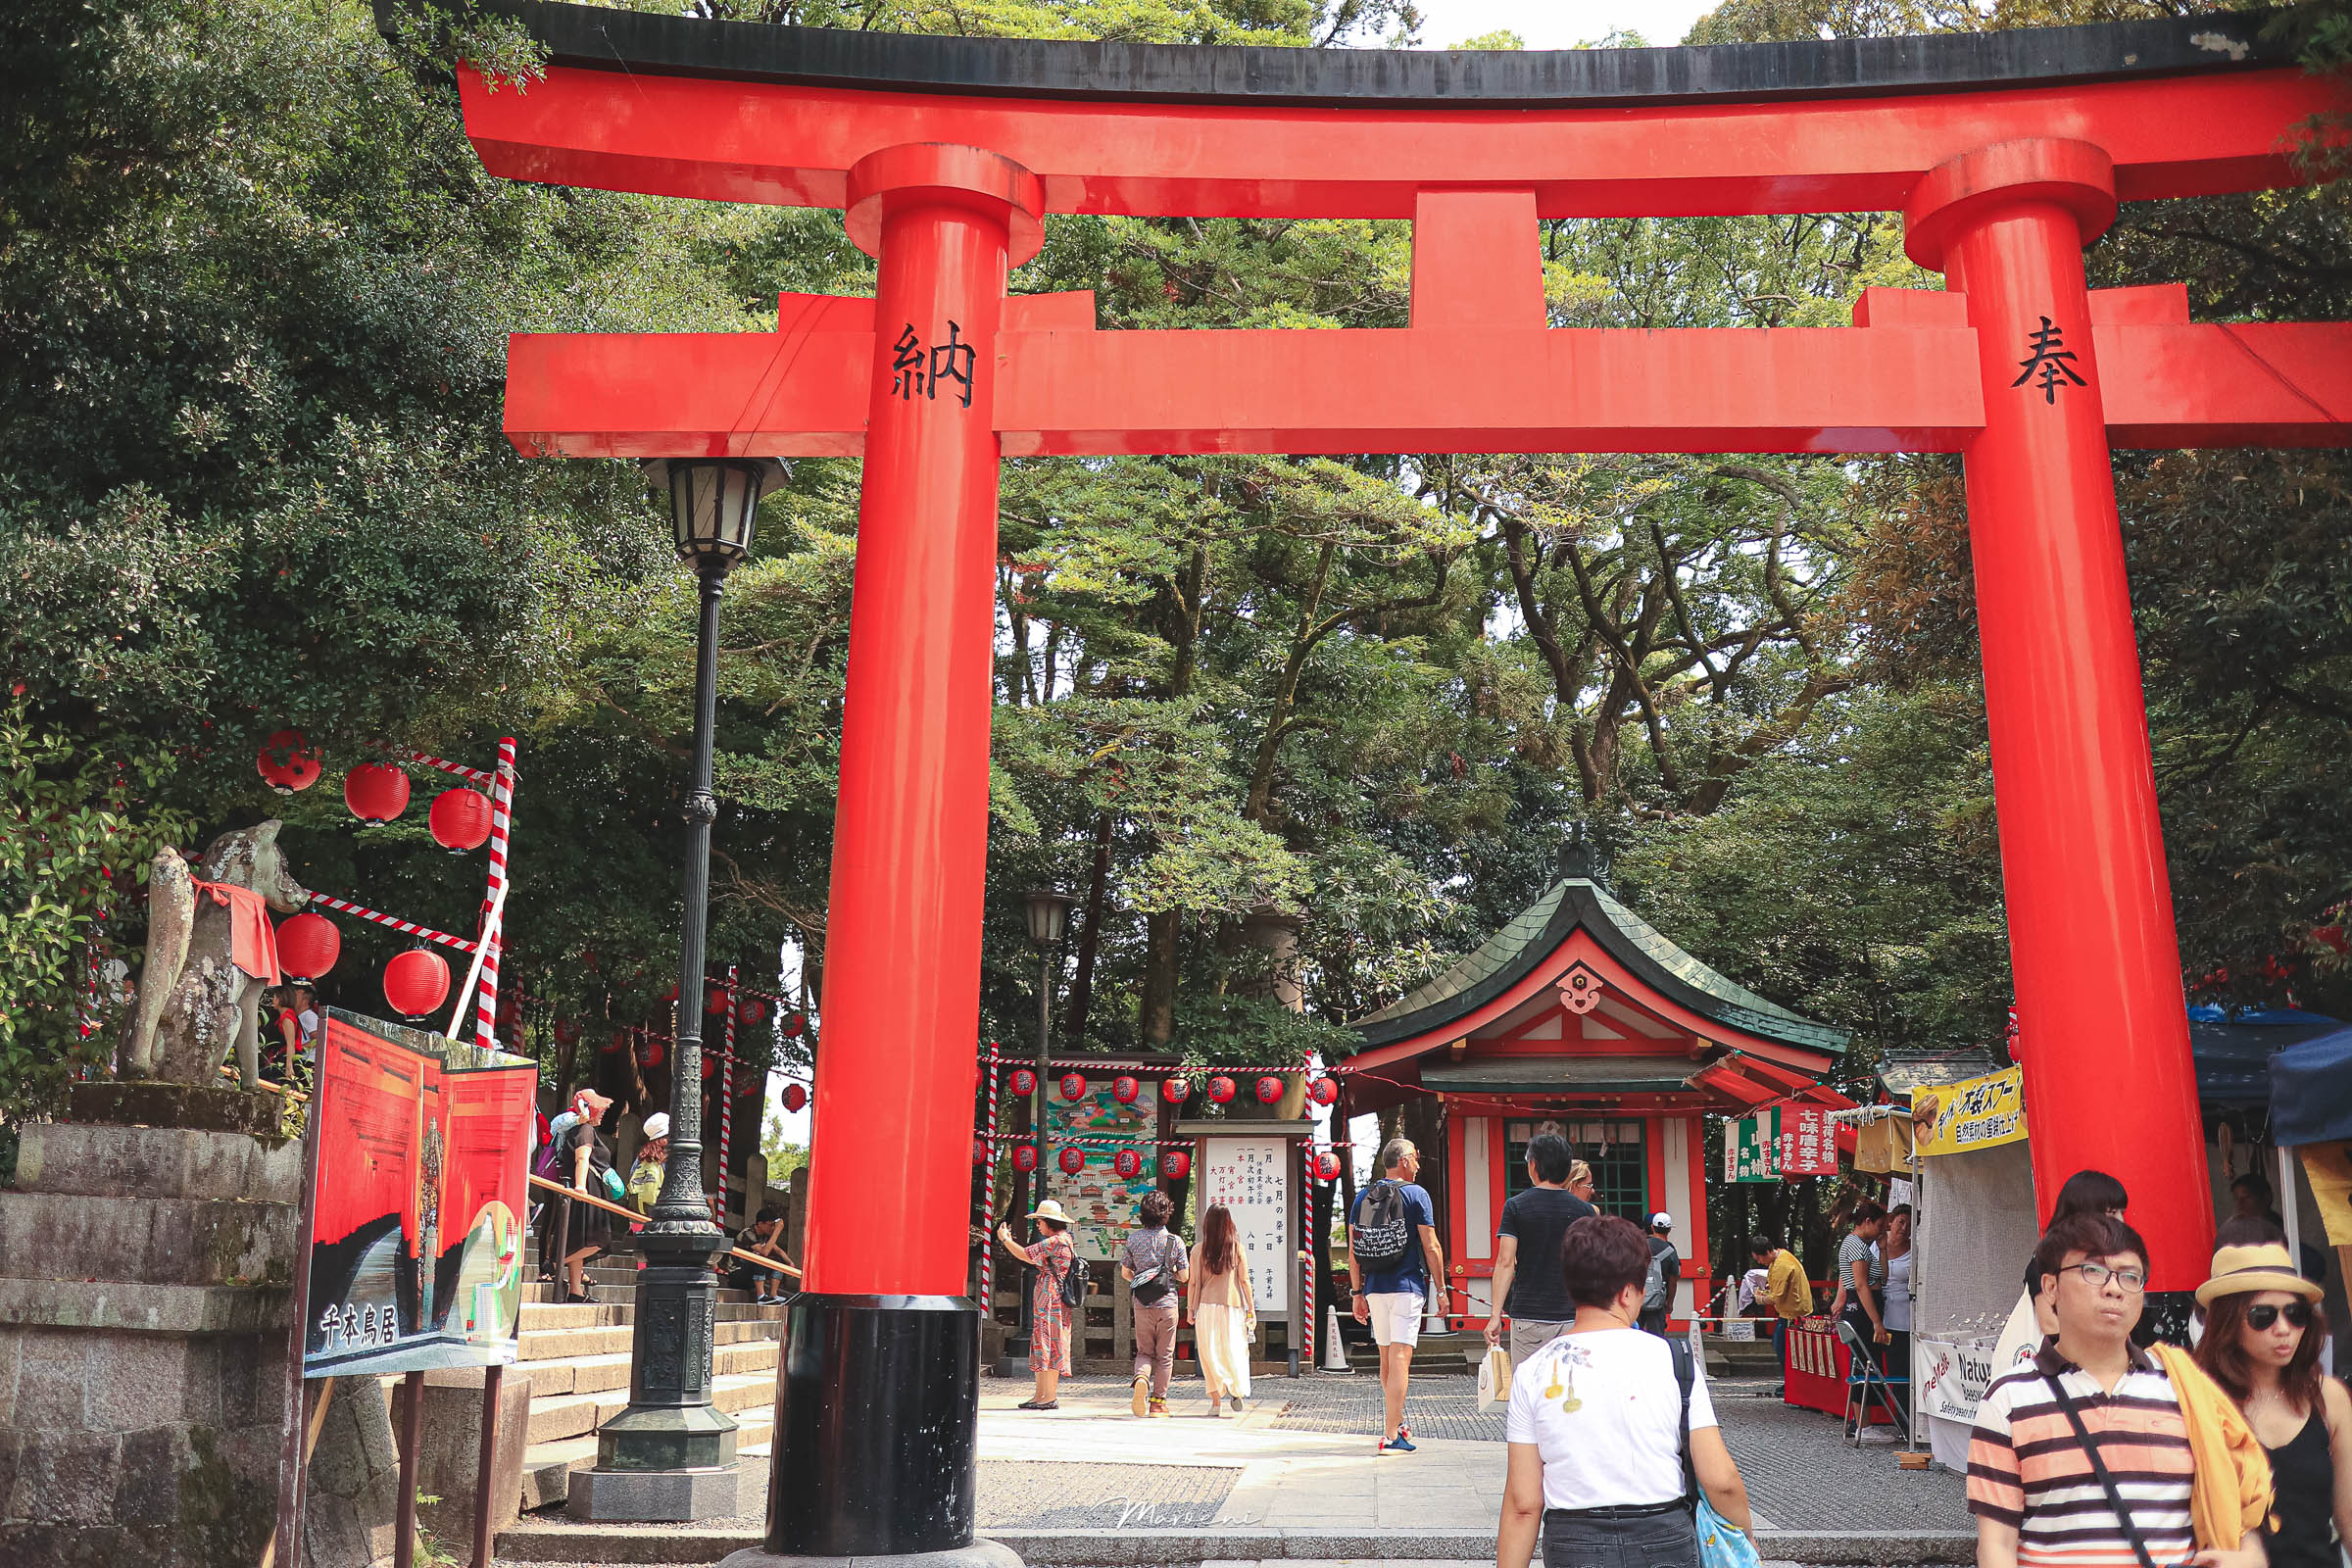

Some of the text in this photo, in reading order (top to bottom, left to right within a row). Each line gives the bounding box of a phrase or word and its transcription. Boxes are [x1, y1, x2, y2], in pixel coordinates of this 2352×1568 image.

[890, 319, 976, 408] 納
[2010, 316, 2088, 405] 奉
[1740, 1147, 1750, 1177] 名物
[1799, 1109, 1819, 1172] 七味唐辛子
[1275, 1176, 1284, 1245] 七月の祭事
[320, 1302, 396, 1349] 千本鳥居
